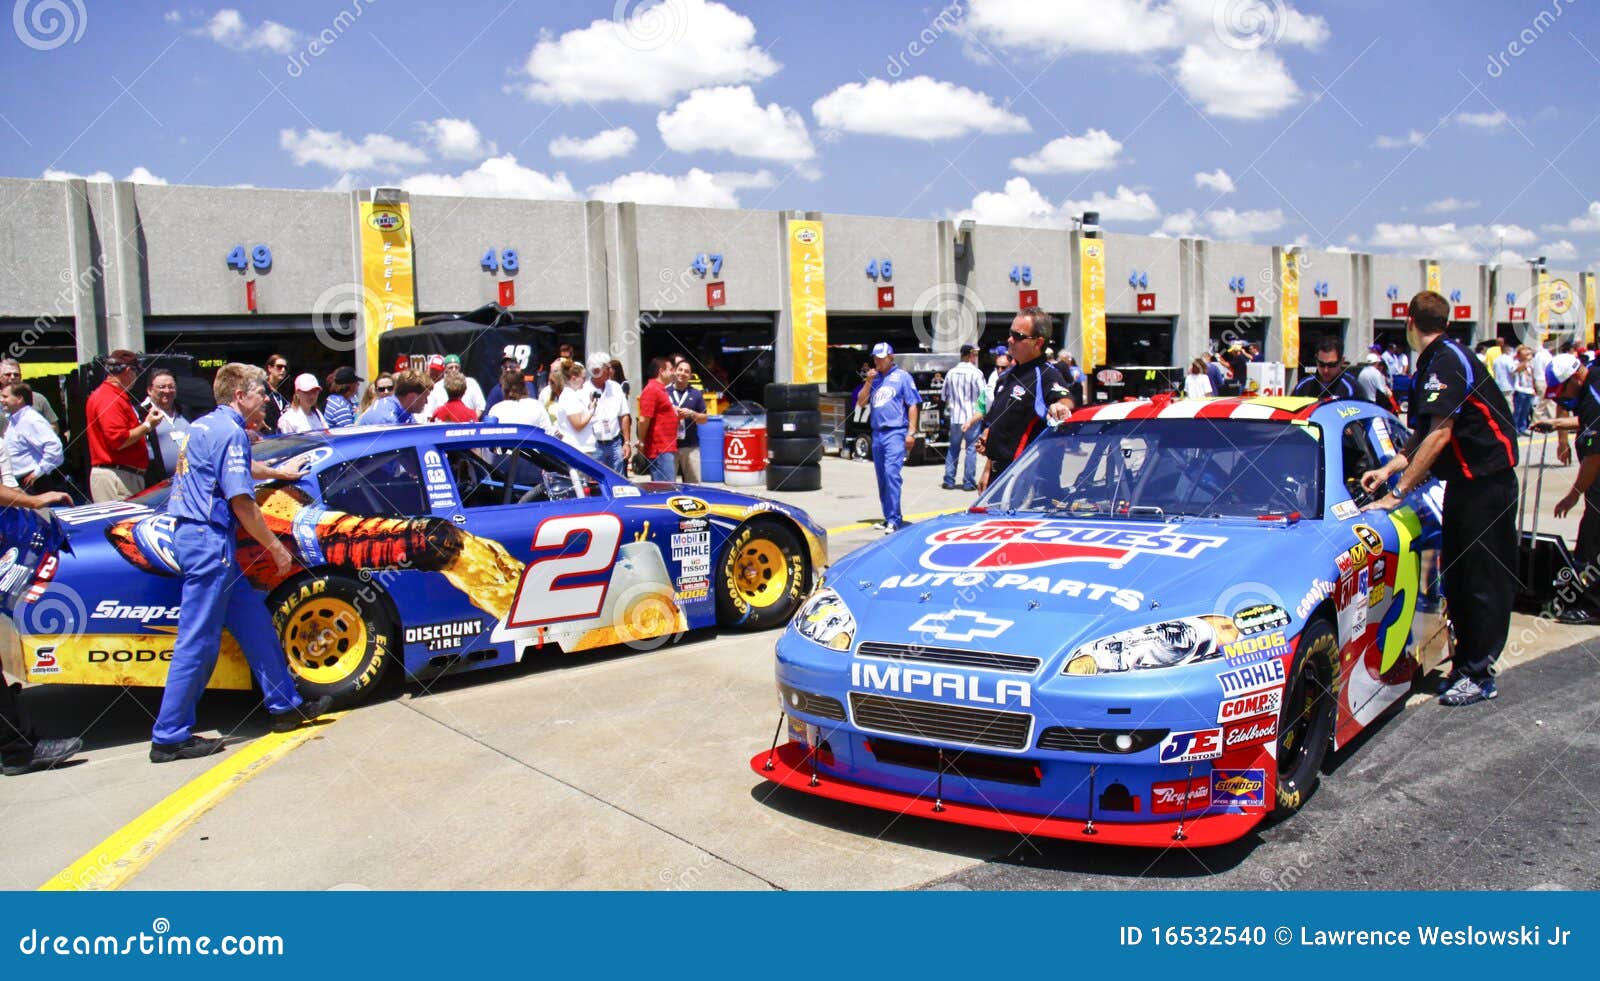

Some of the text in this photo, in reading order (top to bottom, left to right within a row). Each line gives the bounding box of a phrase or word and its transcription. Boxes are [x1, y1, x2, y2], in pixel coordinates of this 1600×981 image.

[227, 245, 272, 275] 49
[384, 242, 393, 292] FEEL
[480, 247, 519, 275] 48
[692, 253, 723, 279] 47
[866, 259, 892, 282] 46
[1009, 266, 1032, 285] 45
[1129, 270, 1147, 289] 44
[673, 533, 707, 545] Mobil 1
[673, 544, 709, 558] MAHLE
[933, 526, 1218, 557] CARQUEST
[508, 512, 623, 628] 2
[675, 590, 708, 600] MOOG
[879, 571, 1144, 611] AUTO PARTS
[91, 600, 182, 623] Snap-o
[404, 619, 483, 643] DISCOUNT
[1244, 619, 1289, 635] BELTS
[427, 637, 462, 650] TIRE
[1223, 631, 1286, 660] MOOG
[88, 650, 176, 663] DODG
[359, 634, 388, 687] EAGLE
[851, 662, 1031, 707] IMPALA
[1219, 660, 1284, 692] MAHLE
[1221, 694, 1268, 718] COMP
[1161, 730, 1219, 761] JE
[1226, 721, 1276, 746] Edelbrock
[1180, 752, 1221, 761] PISTONS
[1217, 781, 1261, 791] SUNOCO
